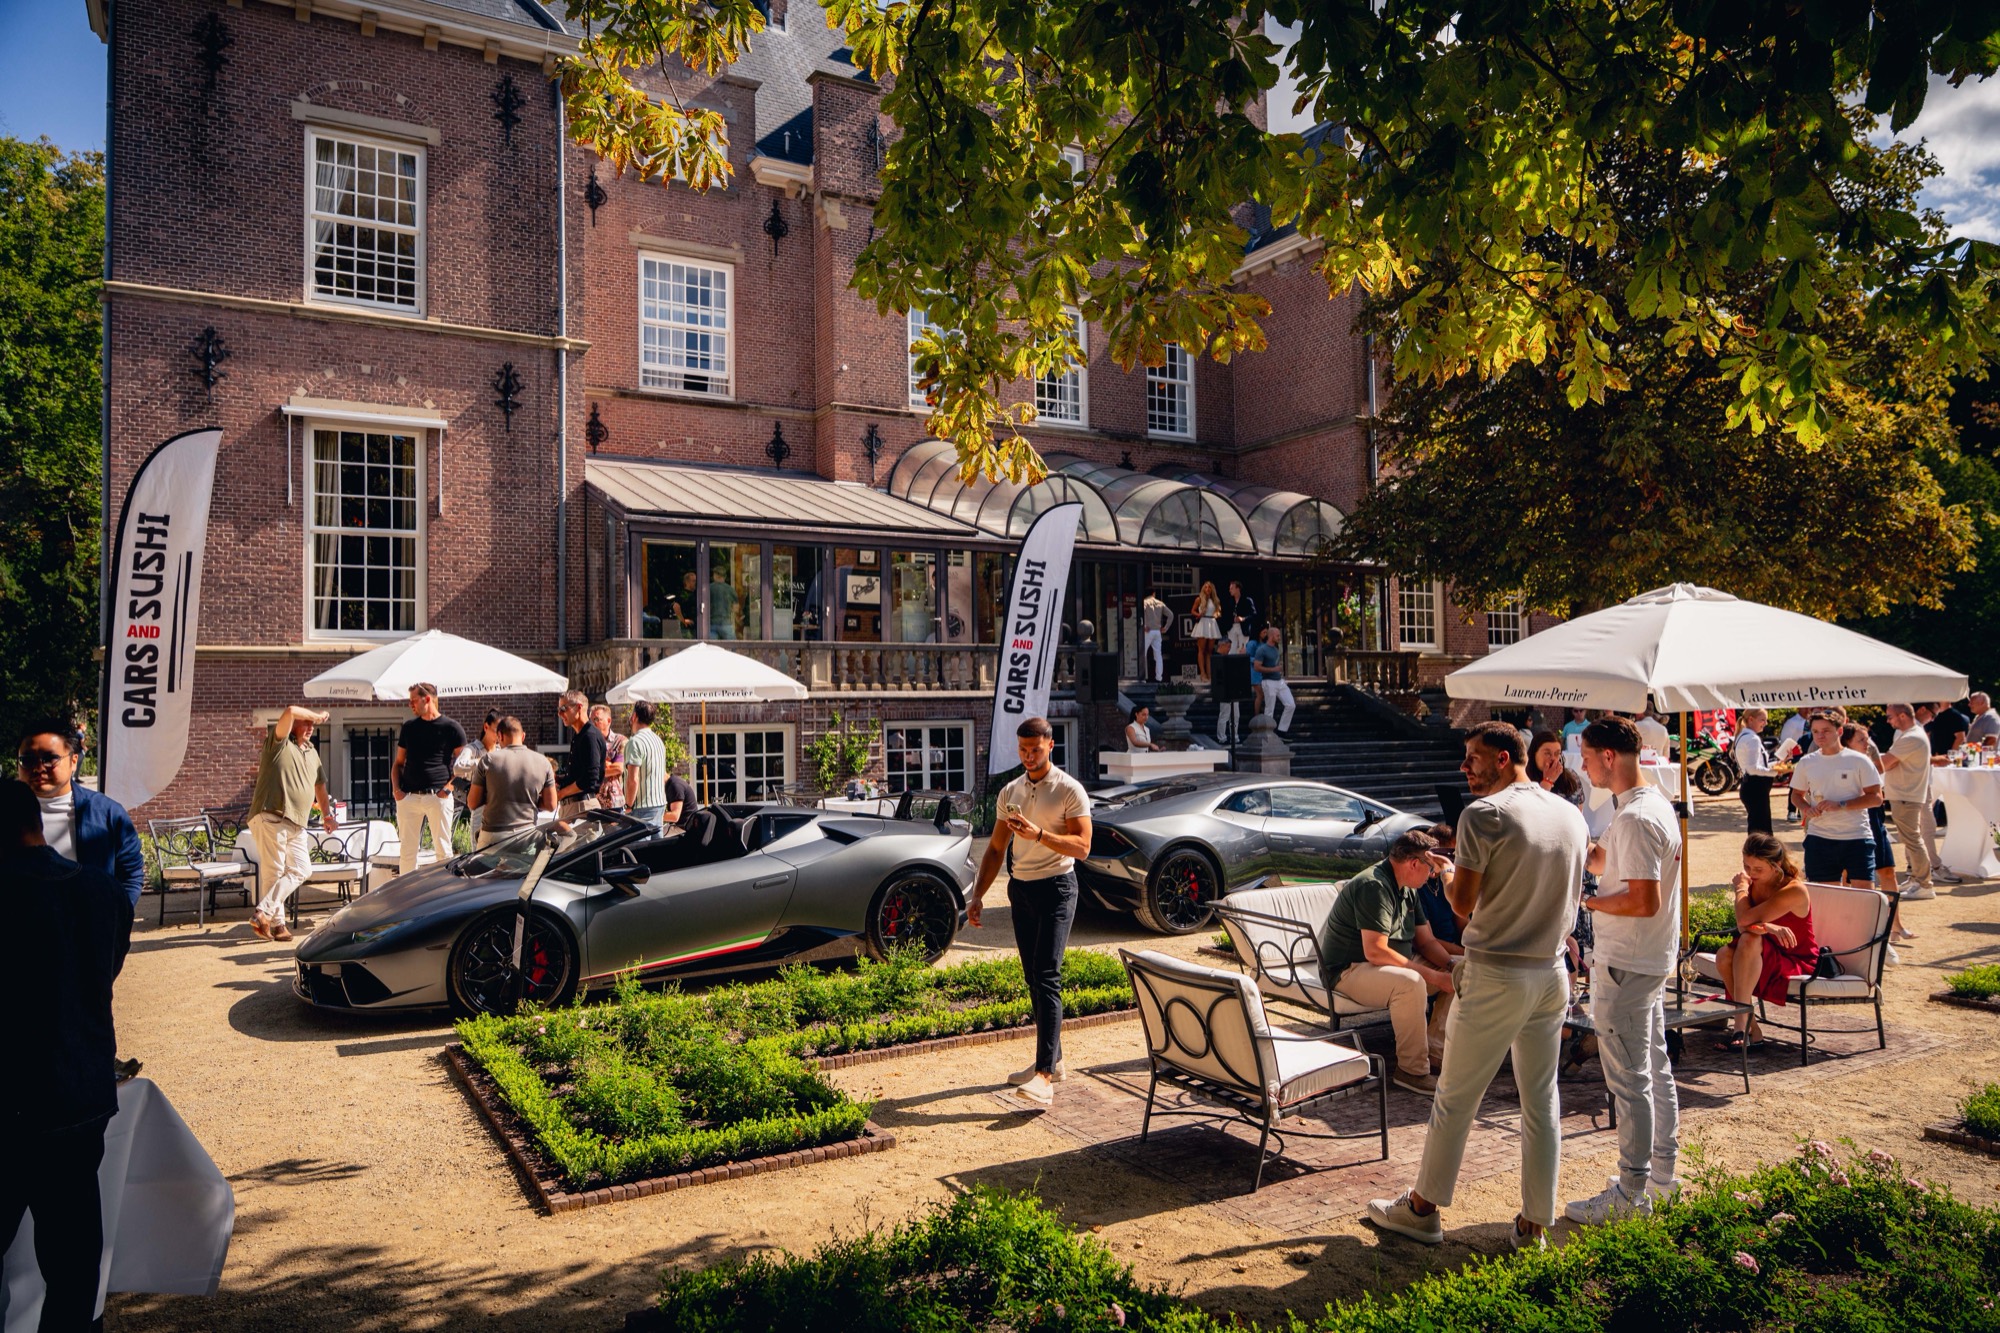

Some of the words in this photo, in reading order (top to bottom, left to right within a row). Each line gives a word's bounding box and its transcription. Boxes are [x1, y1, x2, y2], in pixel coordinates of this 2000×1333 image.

[129, 512, 170, 620] SUSHI
[1015, 558, 1047, 637] SUSHI
[127, 623, 161, 639] AND
[1012, 638, 1033, 651] AND
[122, 643, 159, 728] CARS
[1003, 652, 1031, 714] CARS
[680, 689, 754, 699] Laurent-Perrier
[1504, 684, 1588, 703] Laurent-Perrier
[1740, 686, 1867, 704] Laurent-Perrier
